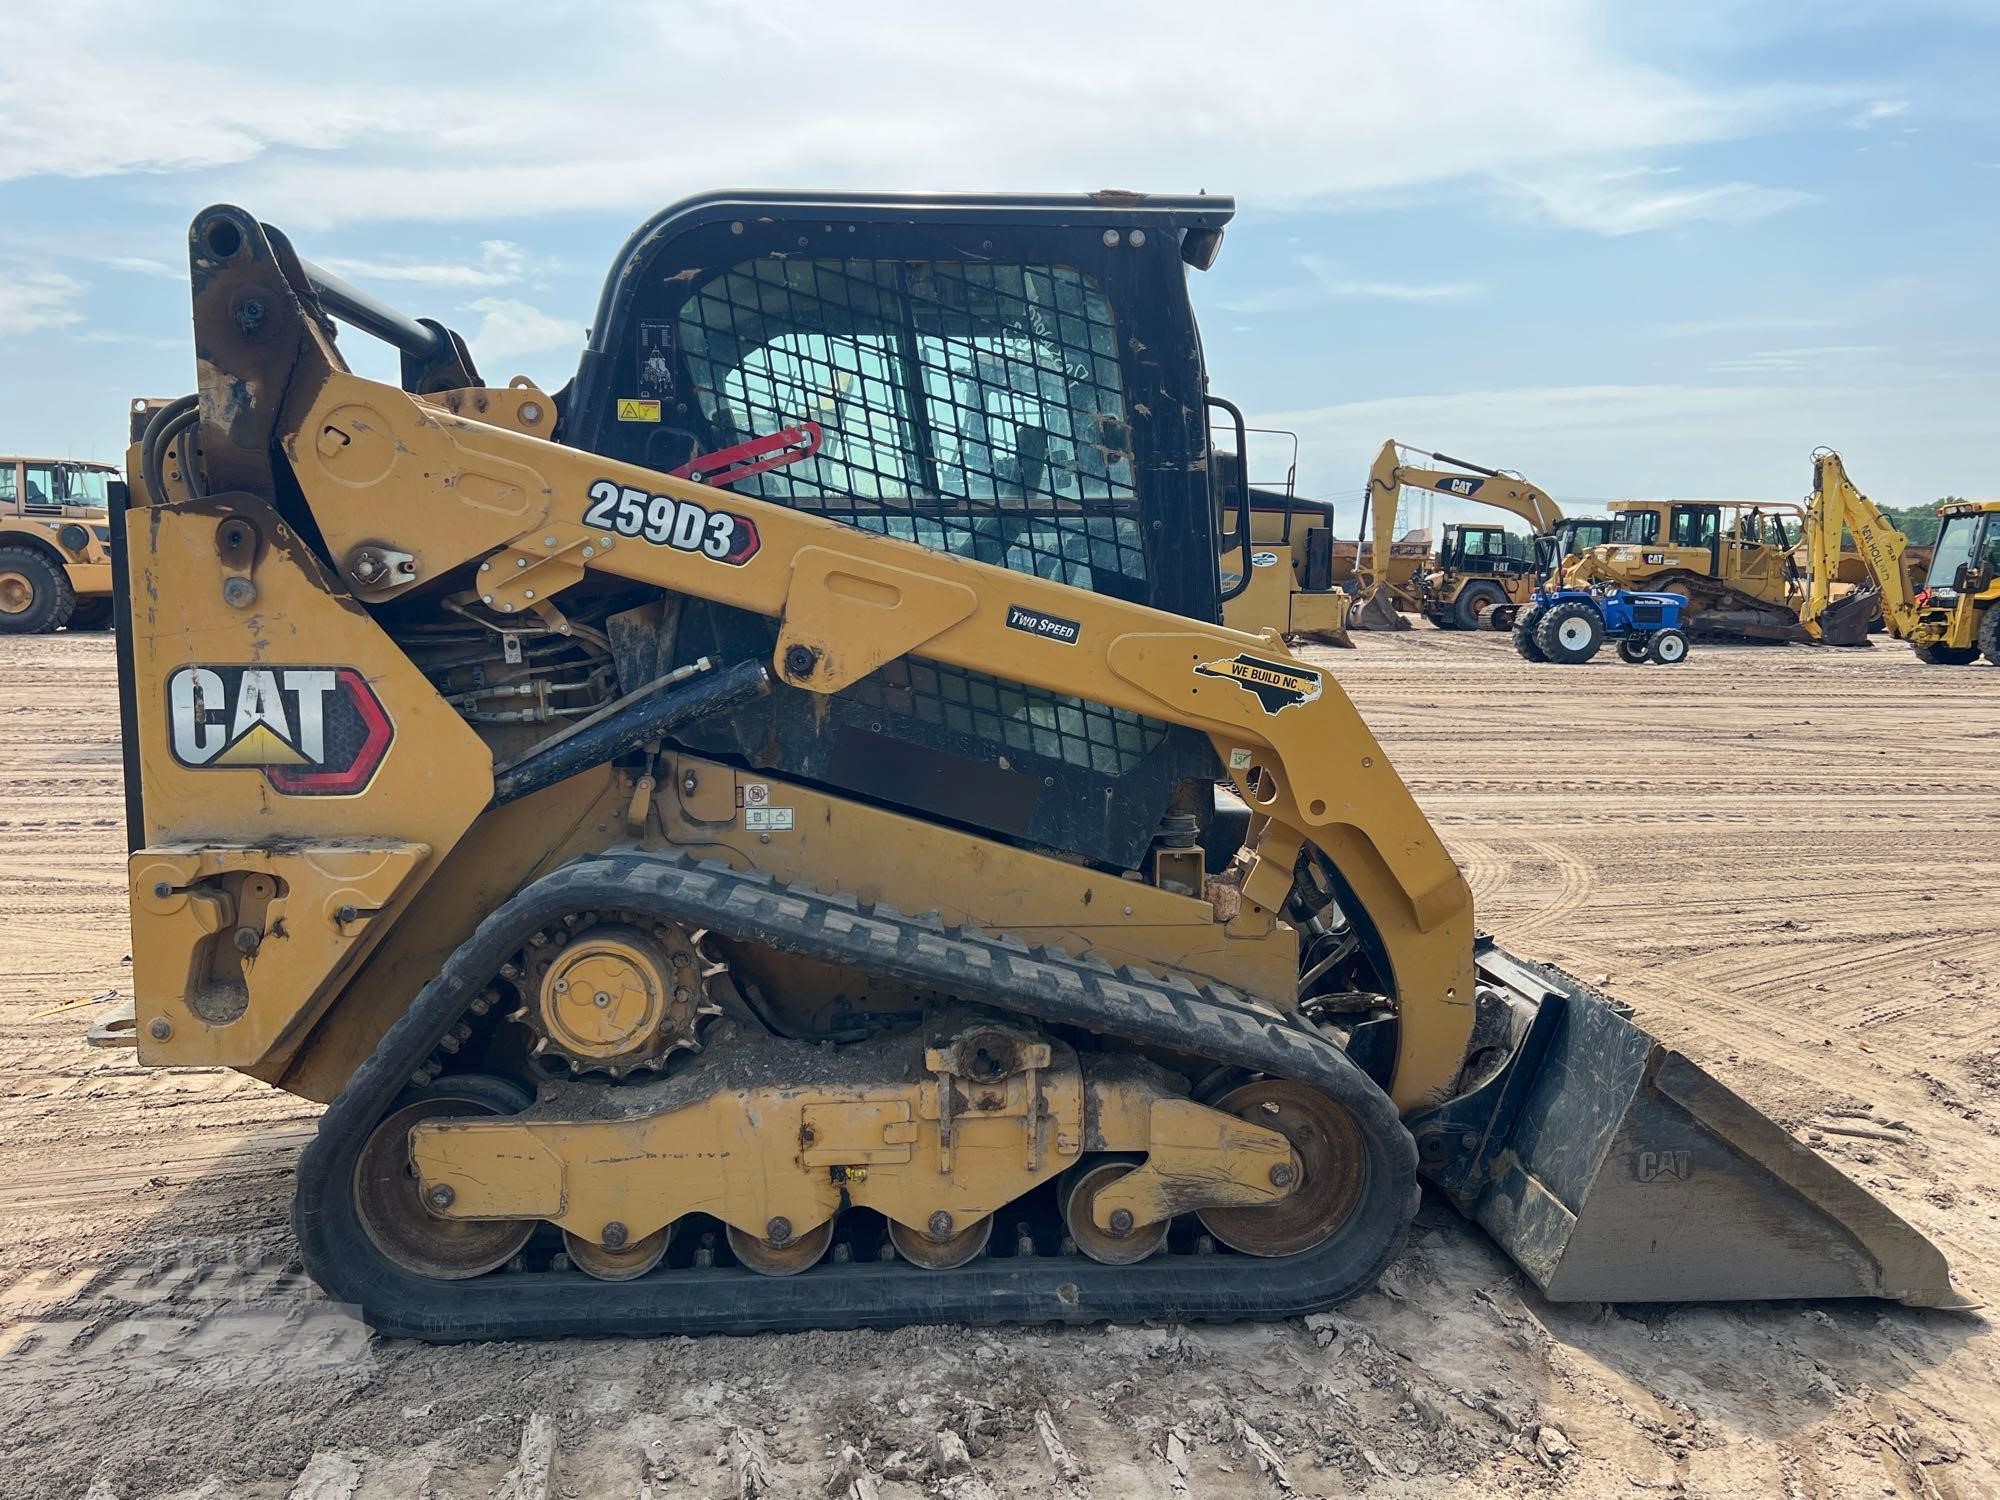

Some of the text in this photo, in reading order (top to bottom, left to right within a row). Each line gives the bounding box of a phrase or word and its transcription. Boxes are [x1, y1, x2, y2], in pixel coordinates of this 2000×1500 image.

[1451, 479, 1472, 494] CAT
[585, 482, 735, 558] 259D3
[1862, 525, 1873, 544] NEW
[1493, 562, 1510, 572] CAT
[1648, 554, 1663, 564] CAT
[1232, 664, 1298, 689] WE BUILD NC
[171, 669, 336, 764] CAT
[1639, 1151, 1691, 1182] CAT
